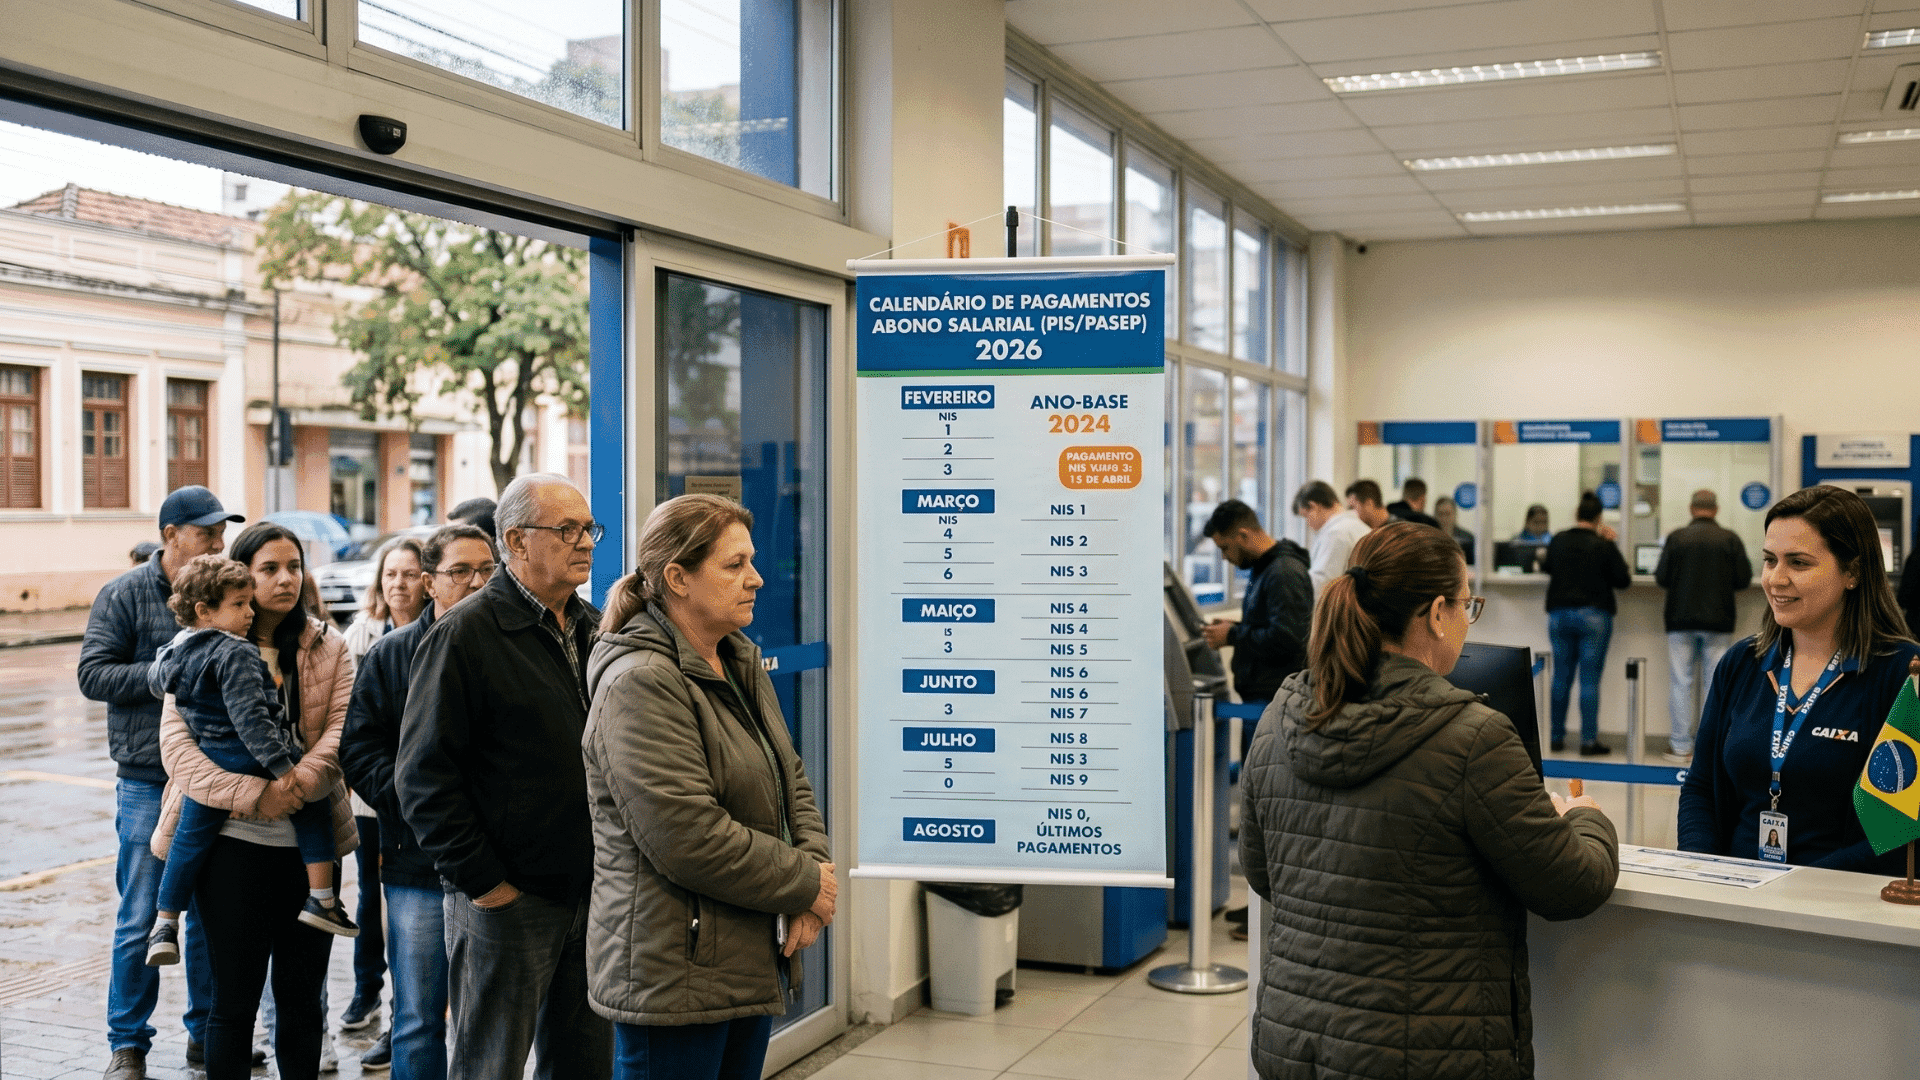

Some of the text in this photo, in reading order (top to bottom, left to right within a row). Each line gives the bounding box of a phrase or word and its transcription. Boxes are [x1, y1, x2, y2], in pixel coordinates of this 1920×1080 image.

[870, 291, 1150, 312] CALENDÁRIO DE PAGAMENTOS
[872, 315, 1147, 334] ABONO SALARIAL (PIS/PASEP)
[976, 340, 1042, 360] 2026
[905, 391, 991, 405] FEVEREIRO
[1031, 395, 1128, 409] ANO-BASE
[939, 413, 957, 421] NIS
[945, 424, 951, 435] 1
[1049, 415, 1110, 433] 2024
[944, 444, 952, 455] 2
[1067, 452, 1134, 461] PAGAMENTO
[944, 464, 952, 475] 3
[1069, 464, 1086, 472] NIS
[1122, 464, 1132, 472] 3:
[1071, 475, 1131, 484] 15 DE ABRIL
[917, 494, 979, 511] MARÇO
[1051, 504, 1086, 515] NIS 1
[939, 516, 957, 524] NIS
[944, 528, 952, 539] 4
[1051, 536, 1088, 546] NIS 2
[944, 548, 952, 559] 5
[944, 568, 952, 579] 6
[1051, 566, 1088, 577] NIS 3
[921, 604, 976, 619] MAIÇO
[1051, 603, 1088, 614] NIS 4
[1051, 624, 1088, 634] NIS 4
[944, 642, 952, 653] 3
[1051, 644, 1088, 655] NIS 5
[1051, 667, 1088, 678] NIS 6
[920, 676, 977, 689] JUNTO
[1051, 688, 1088, 699] NIS 6
[1776, 685, 1788, 713] CAIXA
[944, 704, 953, 714] 3
[1051, 708, 1088, 719] NIS 7
[920, 733, 976, 747] JULHO
[1051, 733, 1088, 744] NIS 8
[1811, 727, 1859, 742] CAIXA
[1771, 730, 1782, 759] CAIXA
[944, 758, 952, 769] 5
[1051, 754, 1088, 765] NIS 3
[944, 777, 953, 789] 0
[1051, 774, 1088, 785] NIS 9
[1048, 808, 1090, 822] NIS 0,
[1762, 818, 1785, 828] CAIXA
[913, 824, 984, 837] AGOSTO
[1037, 823, 1102, 838] ÚLTIMOS
[1017, 842, 1121, 855] PAGAMENTOS
